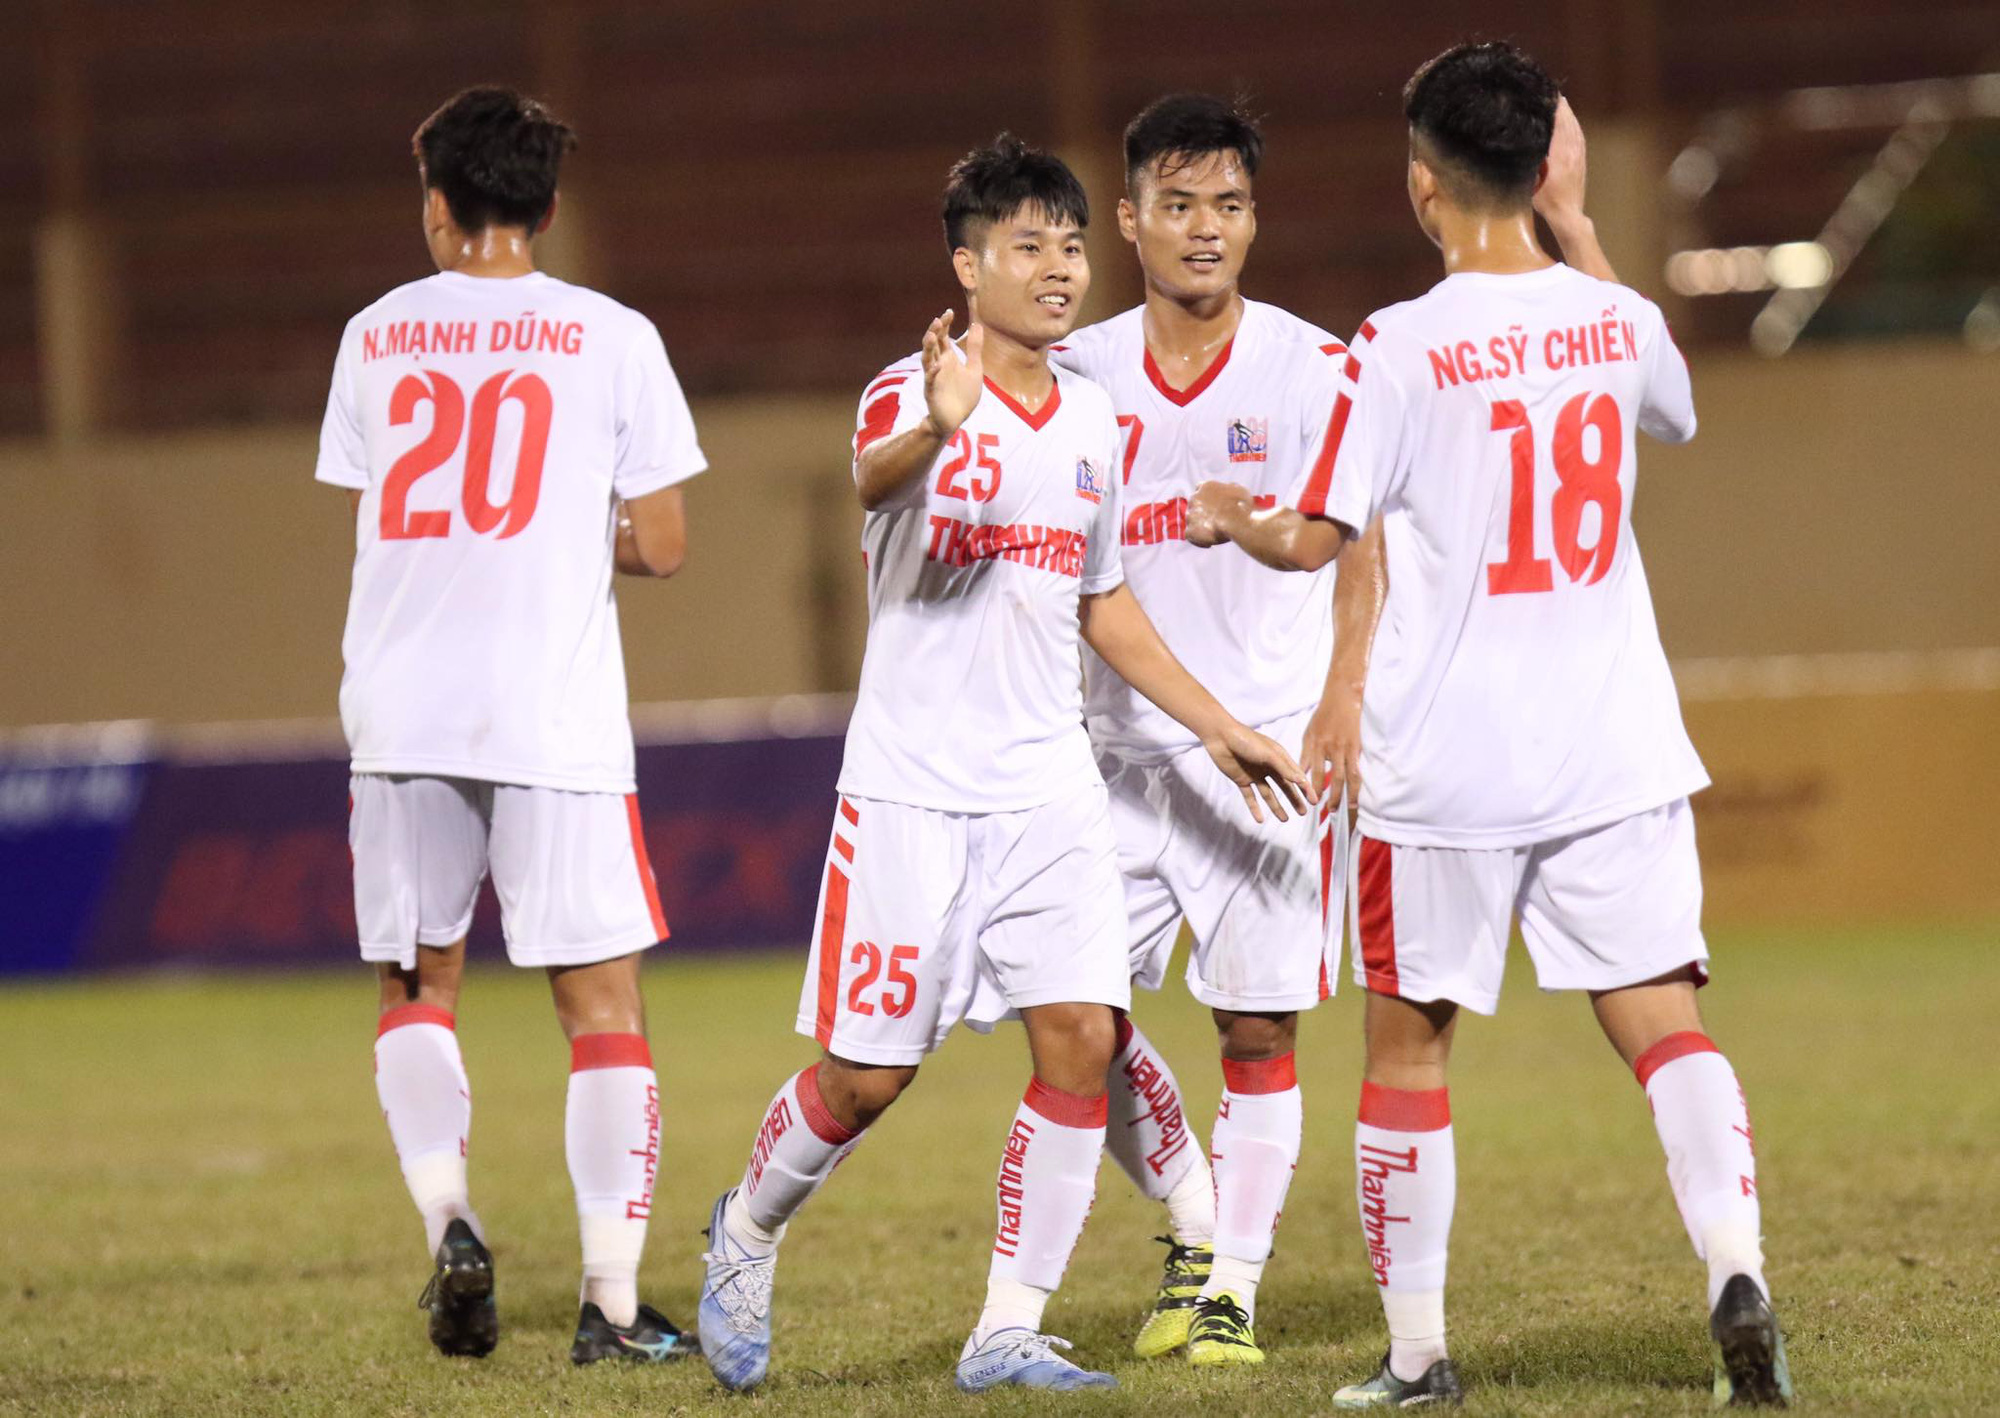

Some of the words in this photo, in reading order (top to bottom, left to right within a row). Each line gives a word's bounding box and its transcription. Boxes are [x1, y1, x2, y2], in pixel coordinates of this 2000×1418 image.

[363, 319, 478, 374] N.MẠNH
[489, 310, 585, 356] DŨNG
[379, 368, 554, 542] 20
[935, 428, 1002, 504] 25
[1486, 390, 1624, 597] 18
[847, 940, 920, 1020] 25
